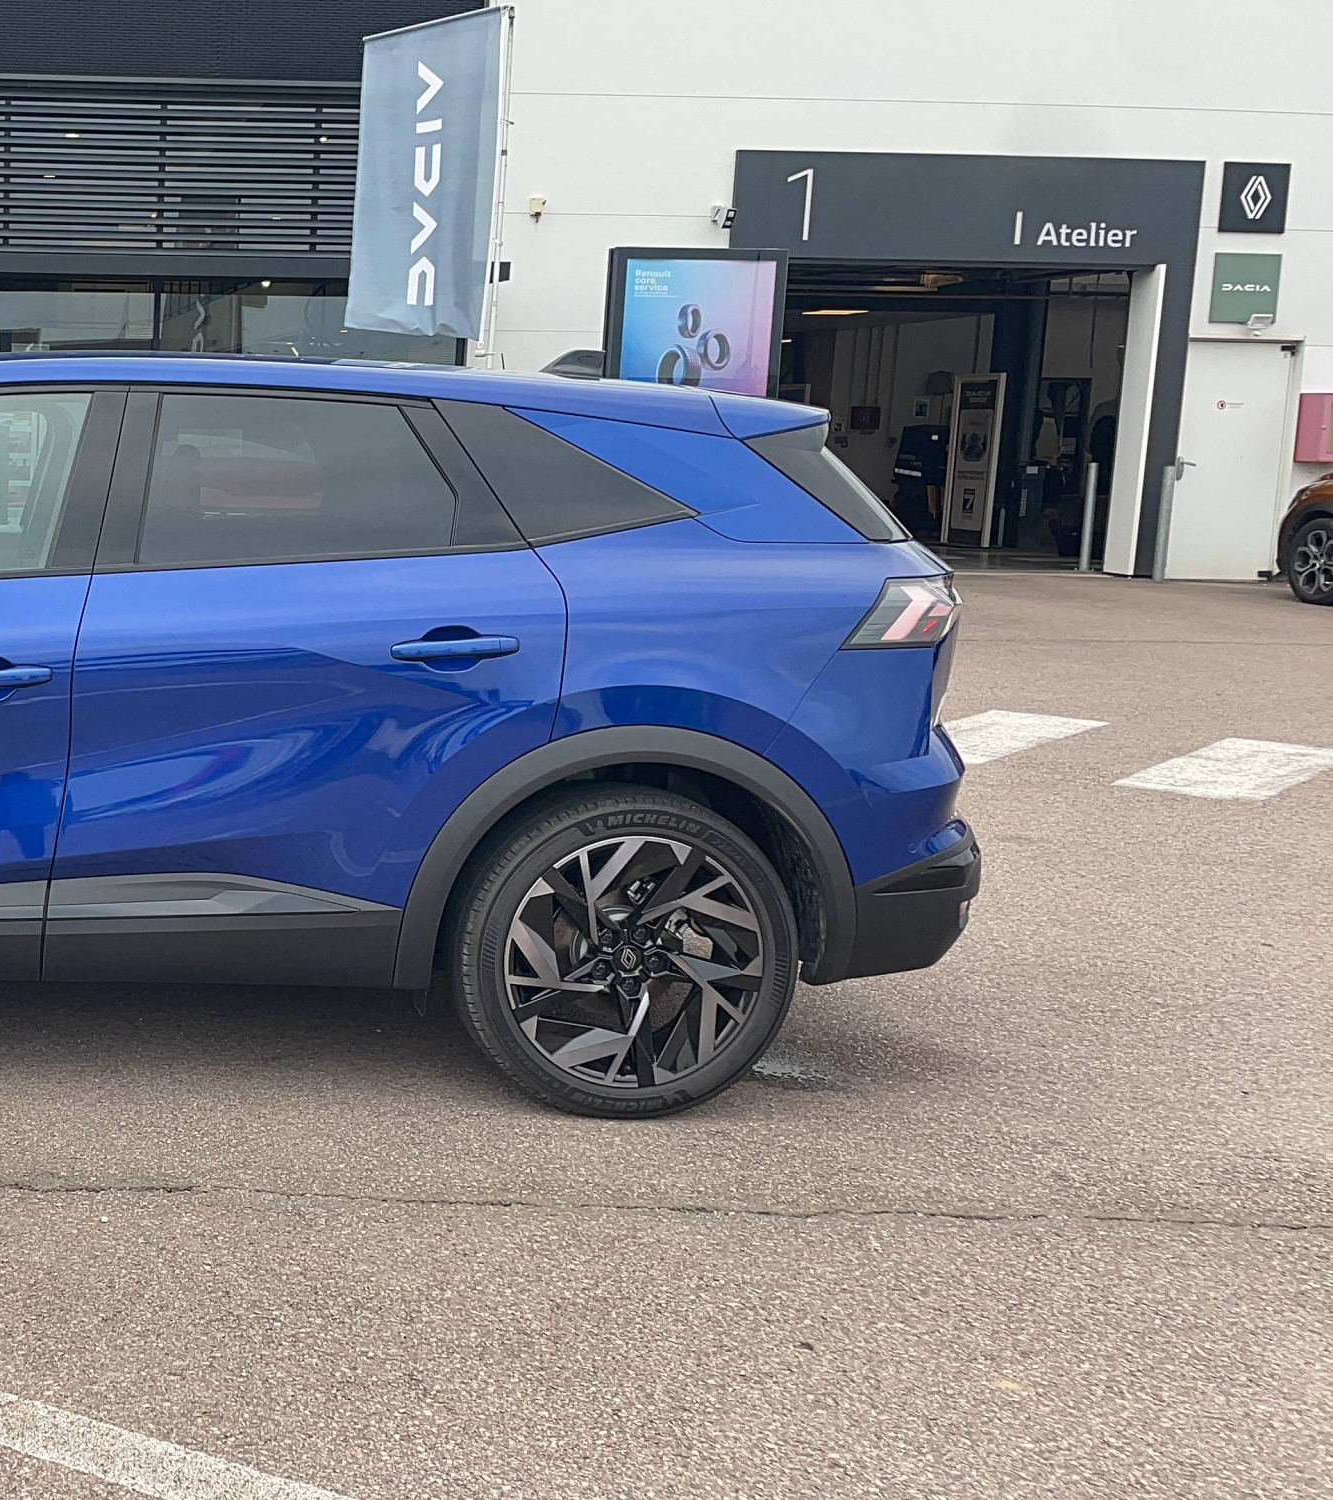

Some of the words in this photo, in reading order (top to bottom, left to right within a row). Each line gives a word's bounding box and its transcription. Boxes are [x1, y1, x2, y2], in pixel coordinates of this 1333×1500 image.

[406, 60, 445, 307] DACIA
[787, 168, 815, 241] 1
[1036, 222, 1138, 248] Atelier
[635, 269, 672, 278] Renault
[634, 284, 669, 292] service
[1221, 283, 1272, 292] DACIA
[964, 494, 974, 509] 7
[608, 813, 701, 834] MICHELIN
